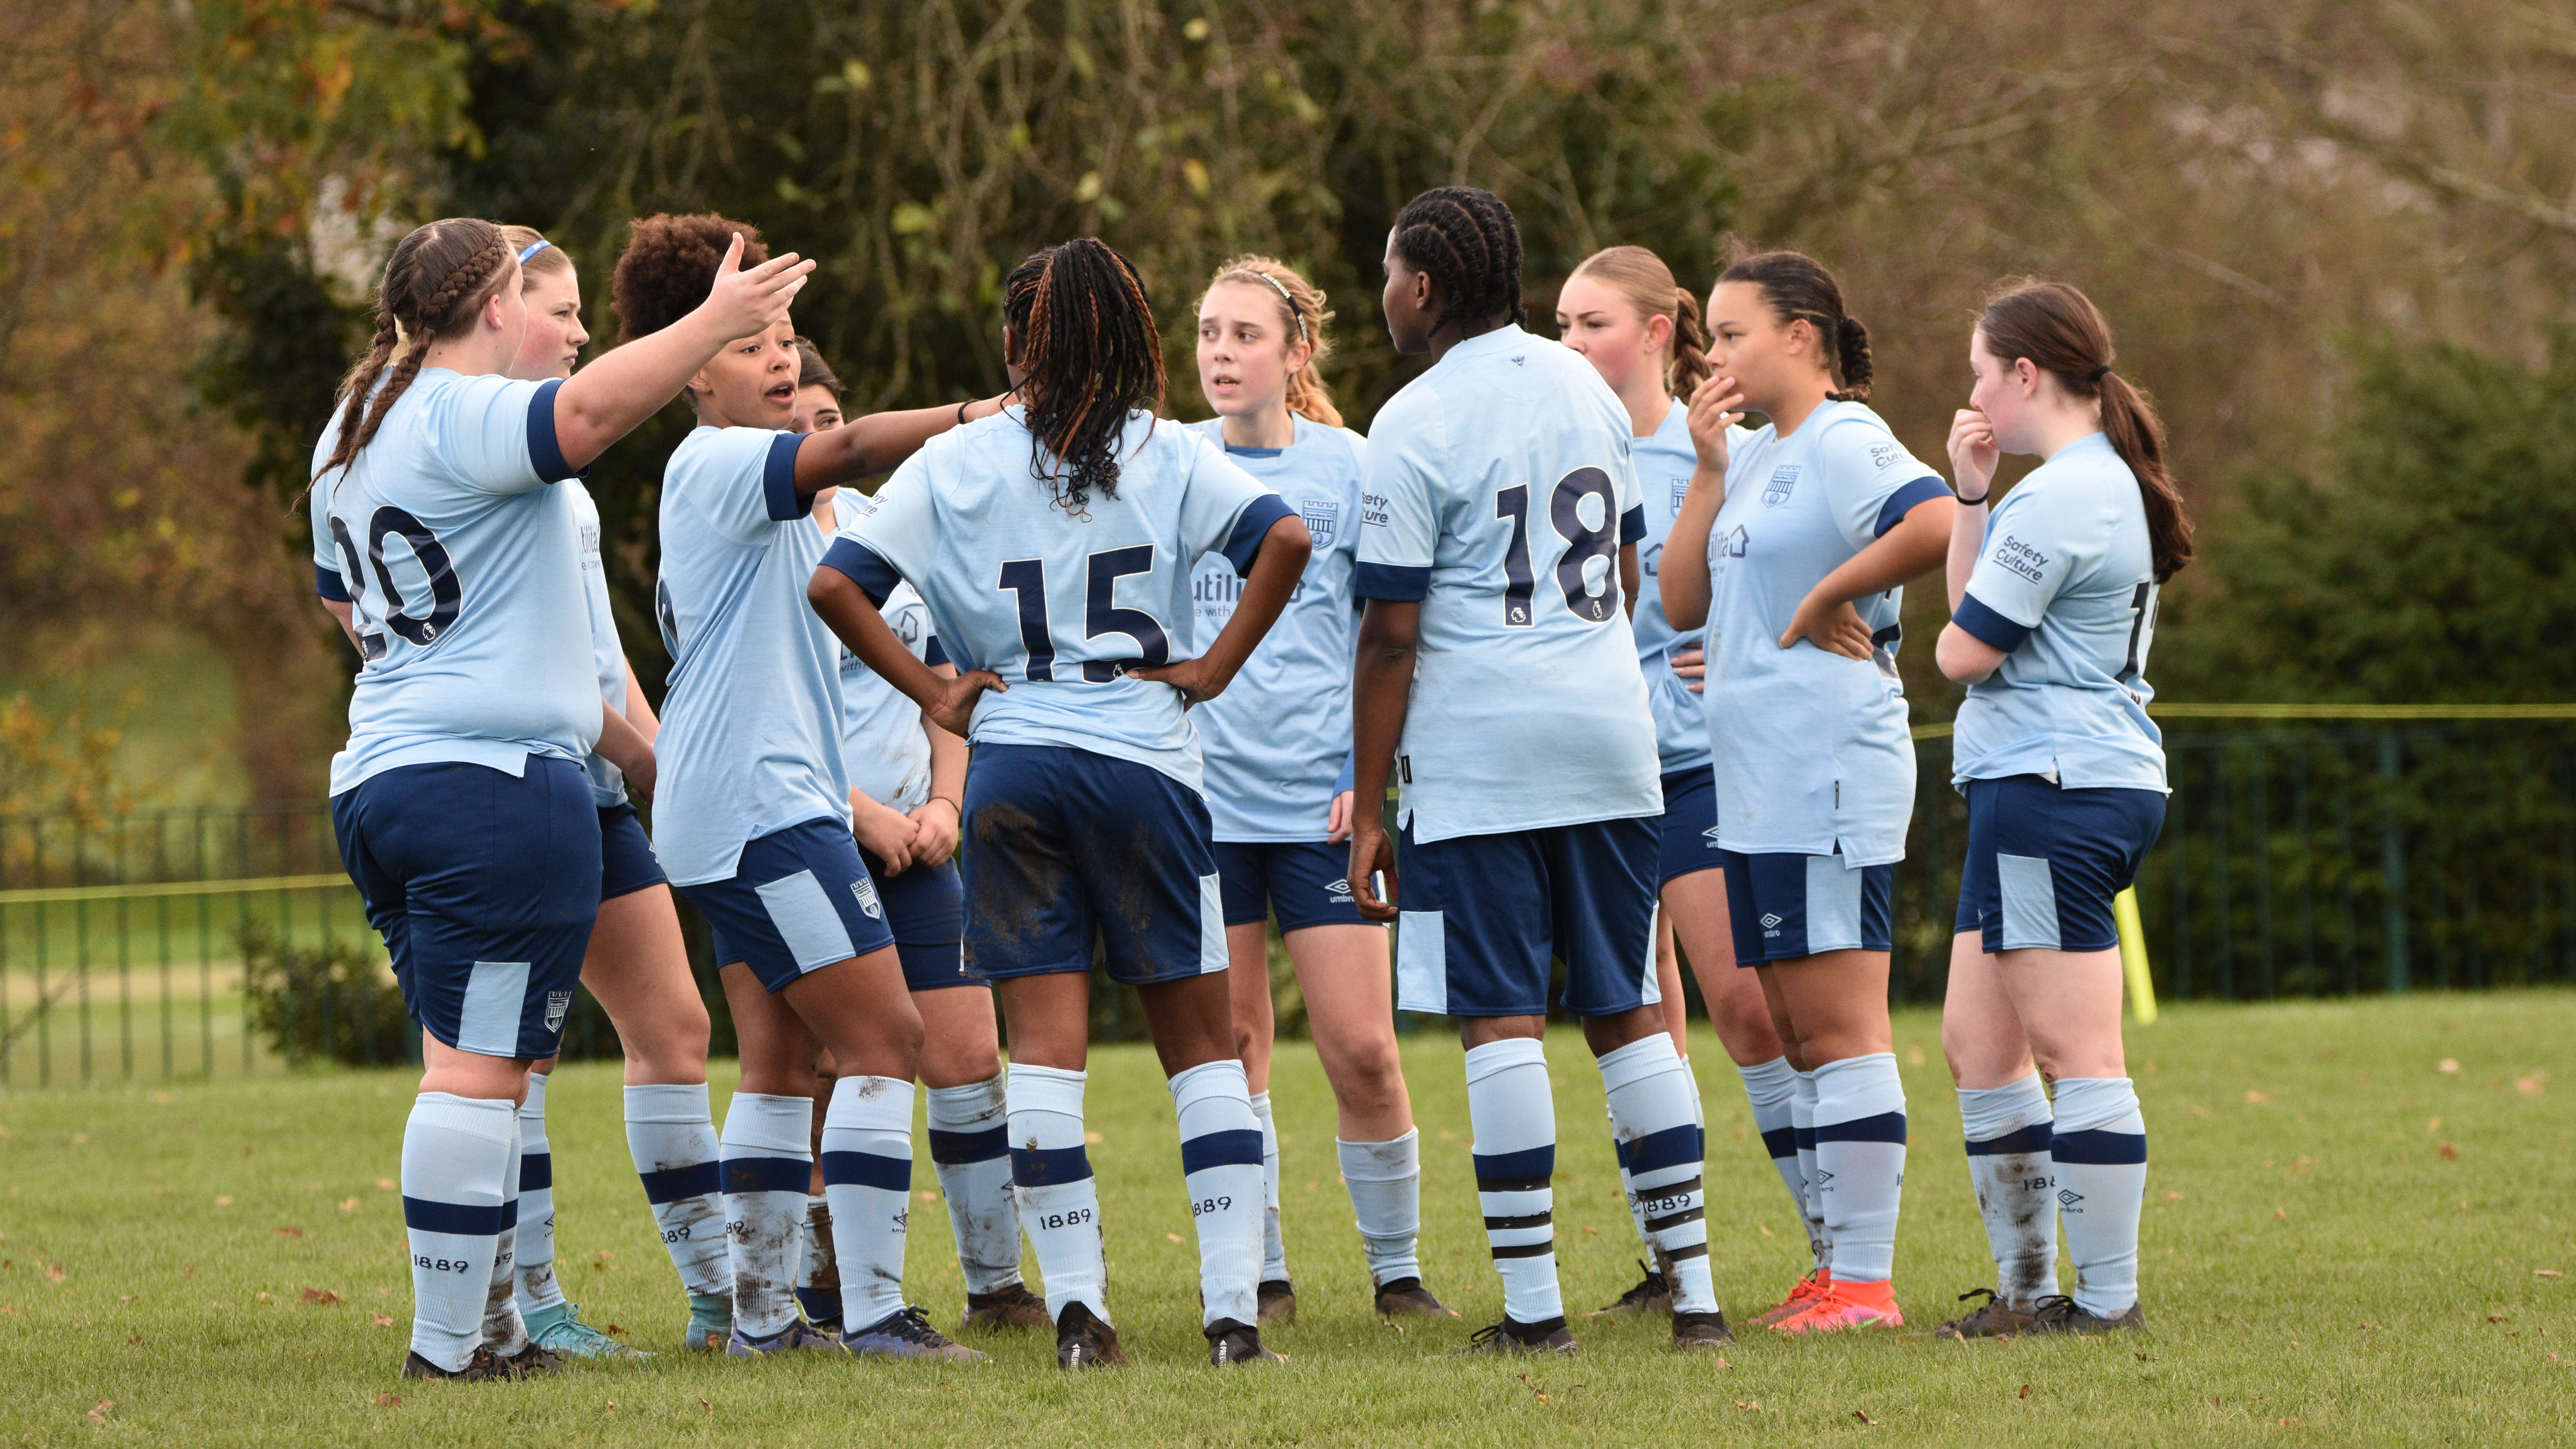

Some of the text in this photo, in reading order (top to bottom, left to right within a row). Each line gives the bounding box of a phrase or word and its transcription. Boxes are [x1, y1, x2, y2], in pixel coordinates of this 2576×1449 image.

[1363, 507, 1388, 523] ure
[581, 525, 598, 554] tilita
[1495, 465, 1618, 628] 18
[1709, 531, 1728, 562] ilita
[2004, 536, 2049, 568] Safety
[1996, 549, 2043, 580] Culture
[330, 504, 463, 664] 20
[996, 551, 1171, 684] 15
[1205, 605, 1230, 617] with
[1040, 1208, 1091, 1230] 1889
[1643, 1194, 1691, 1214] 1889
[414, 1254, 468, 1273] 1889
